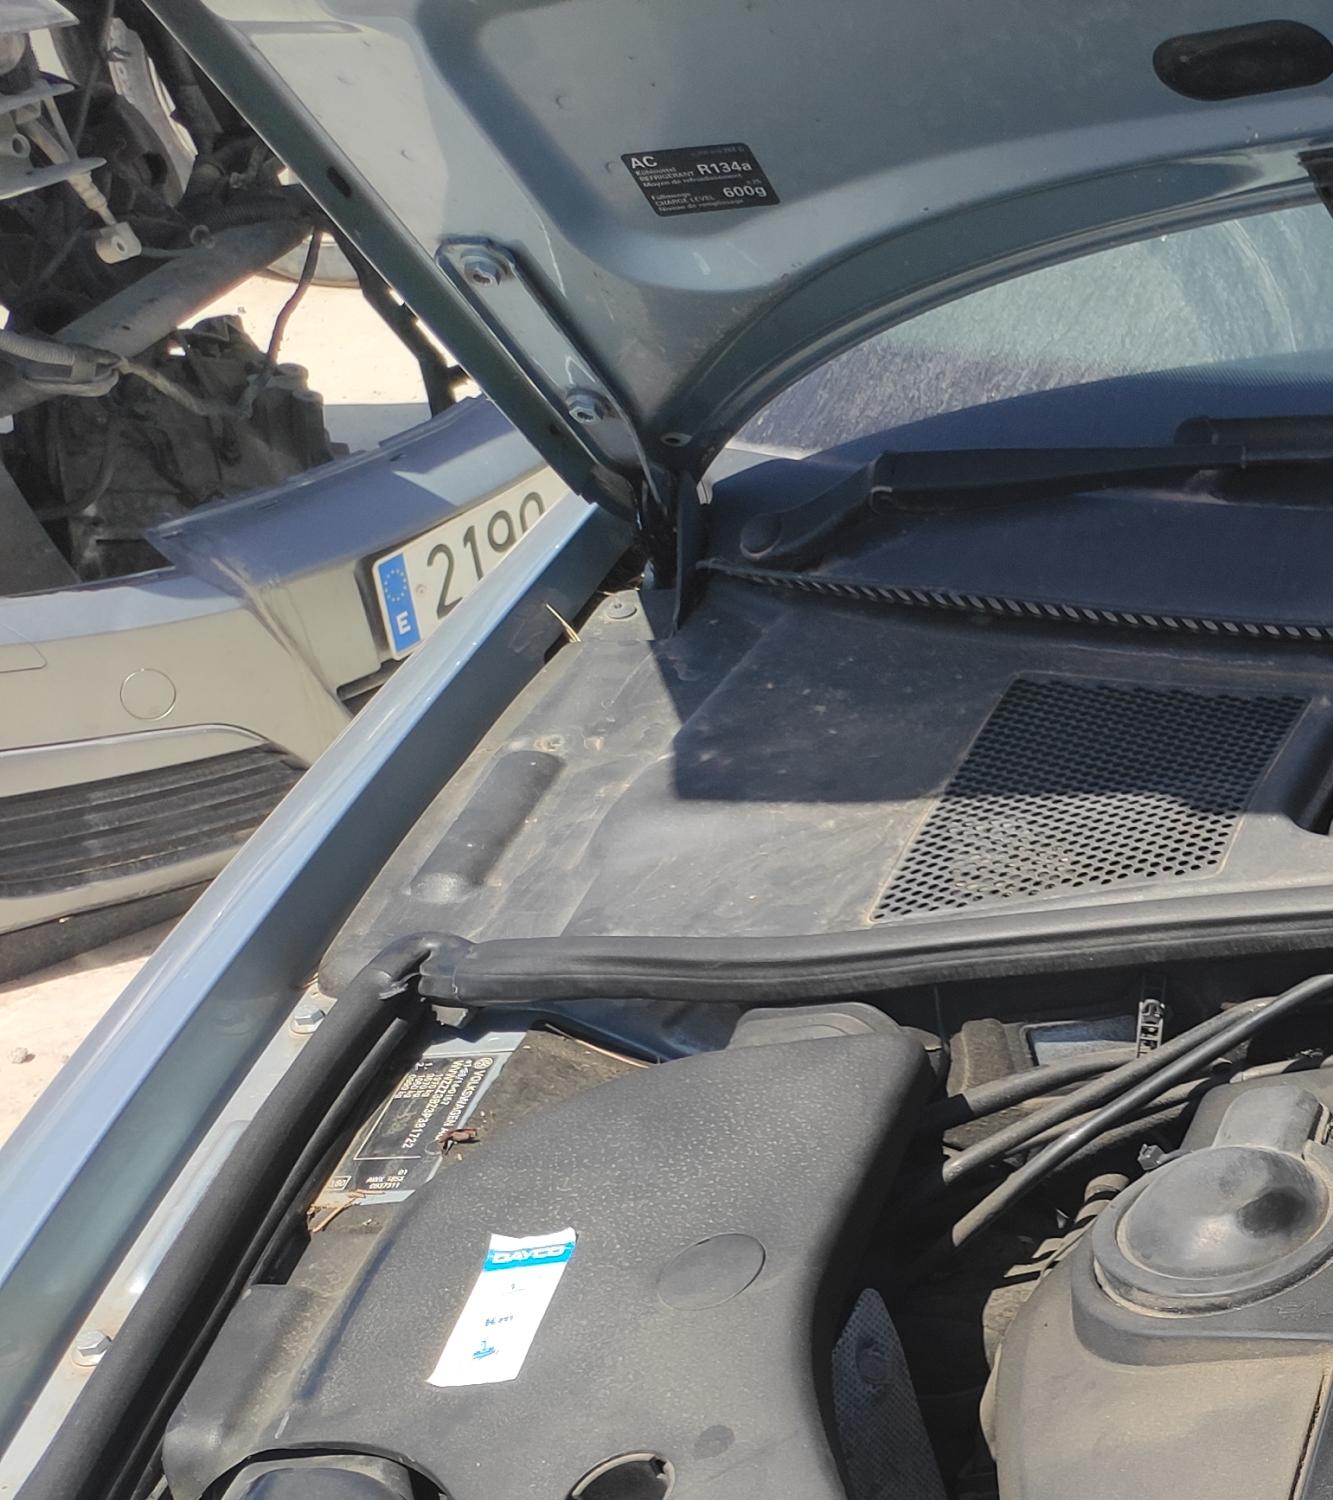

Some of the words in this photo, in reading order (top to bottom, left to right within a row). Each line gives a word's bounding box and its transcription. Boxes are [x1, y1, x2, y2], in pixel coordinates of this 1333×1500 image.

[631, 156, 659, 169] AC
[696, 161, 752, 176] R134a
[723, 185, 767, 198] 600g
[396, 611, 411, 635] E
[443, 1069, 486, 1127] VOLKSWAGEN
[491, 1245, 566, 1264] DAYCO
